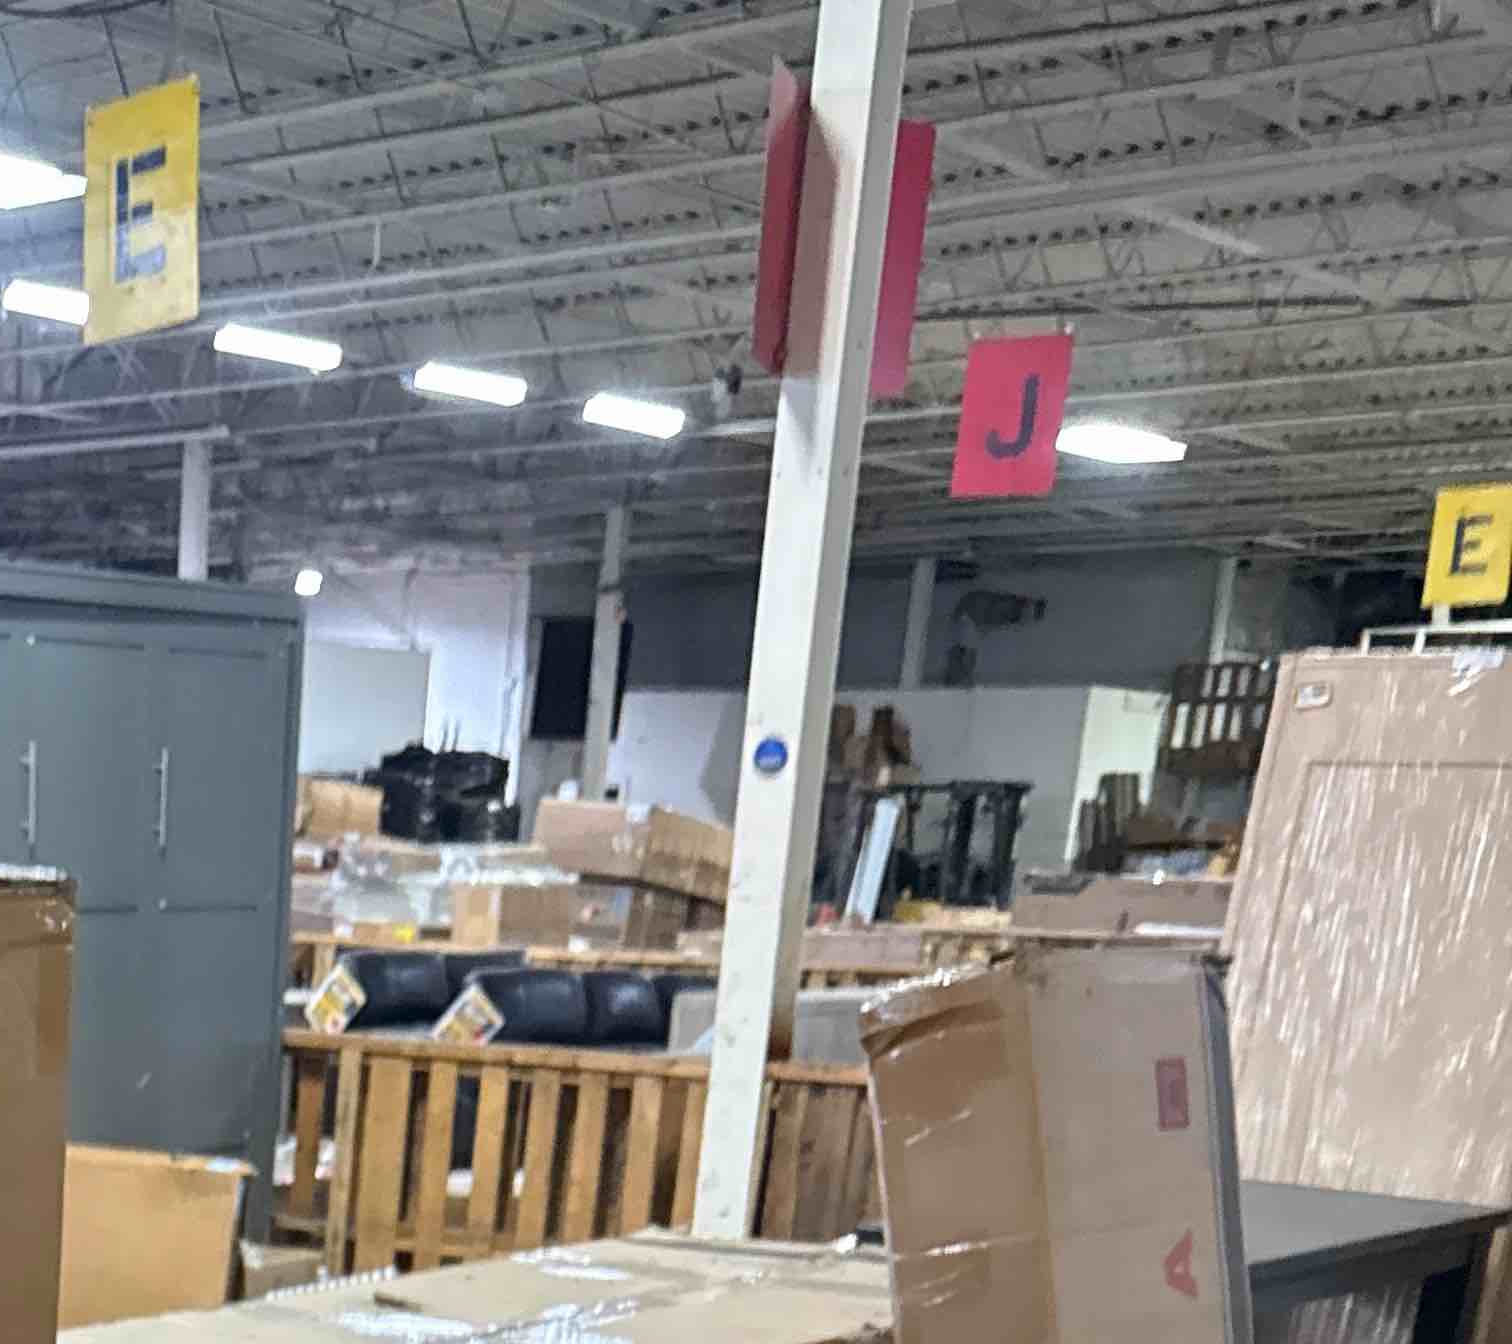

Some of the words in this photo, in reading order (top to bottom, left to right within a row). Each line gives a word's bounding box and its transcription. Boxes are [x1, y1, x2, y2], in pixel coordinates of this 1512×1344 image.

[115, 145, 167, 284] E
[986, 372, 1040, 460] J
[1448, 511, 1494, 577] E
